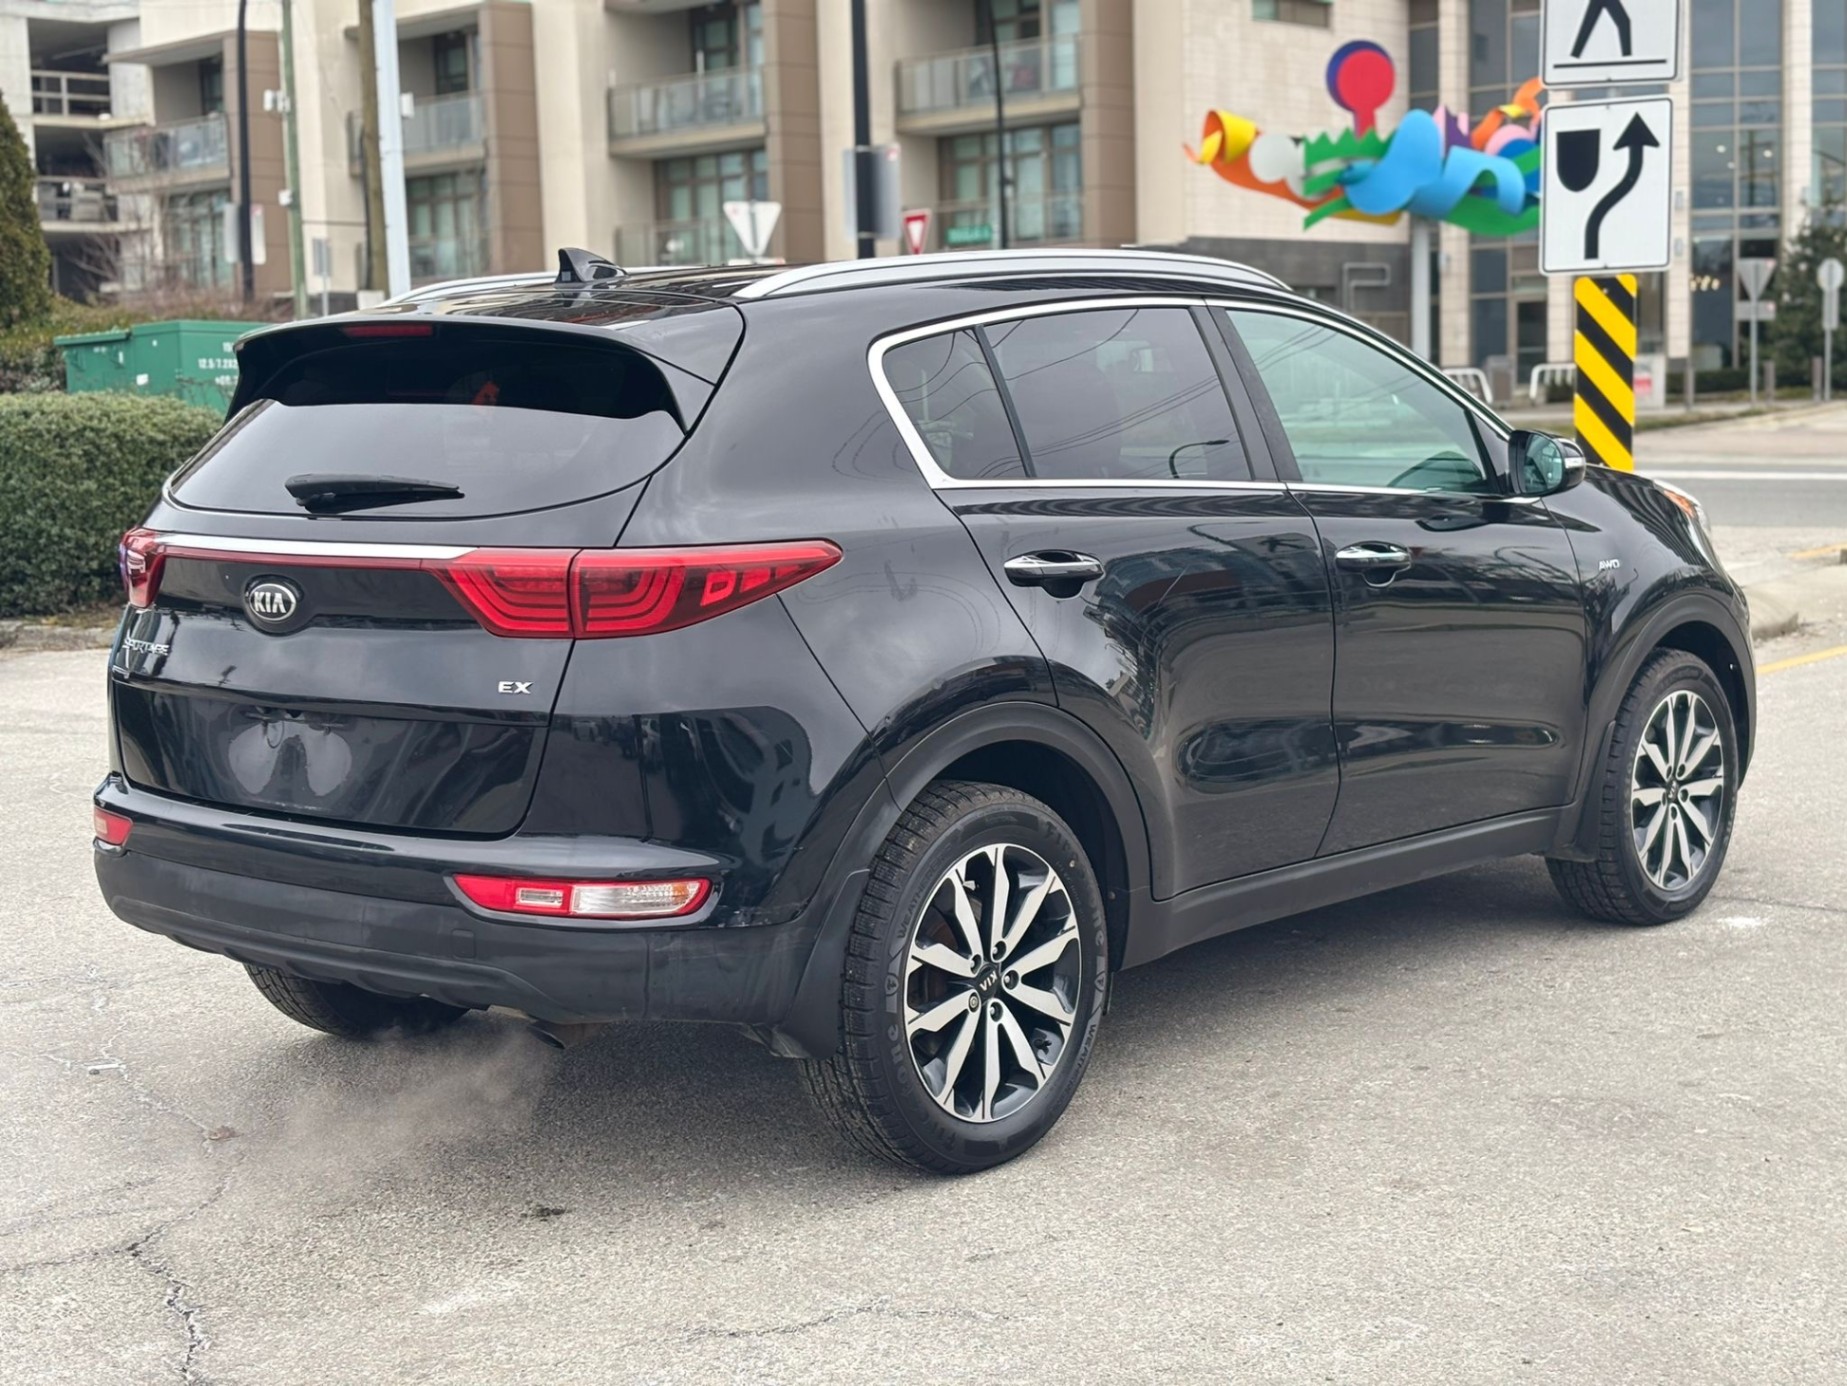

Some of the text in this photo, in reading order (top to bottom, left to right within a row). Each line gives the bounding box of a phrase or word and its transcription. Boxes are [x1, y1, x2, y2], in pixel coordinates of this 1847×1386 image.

[1598, 558, 1621, 571] AWD
[254, 591, 287, 613] KIA
[498, 680, 534, 694] EX
[979, 970, 998, 991] KIA
